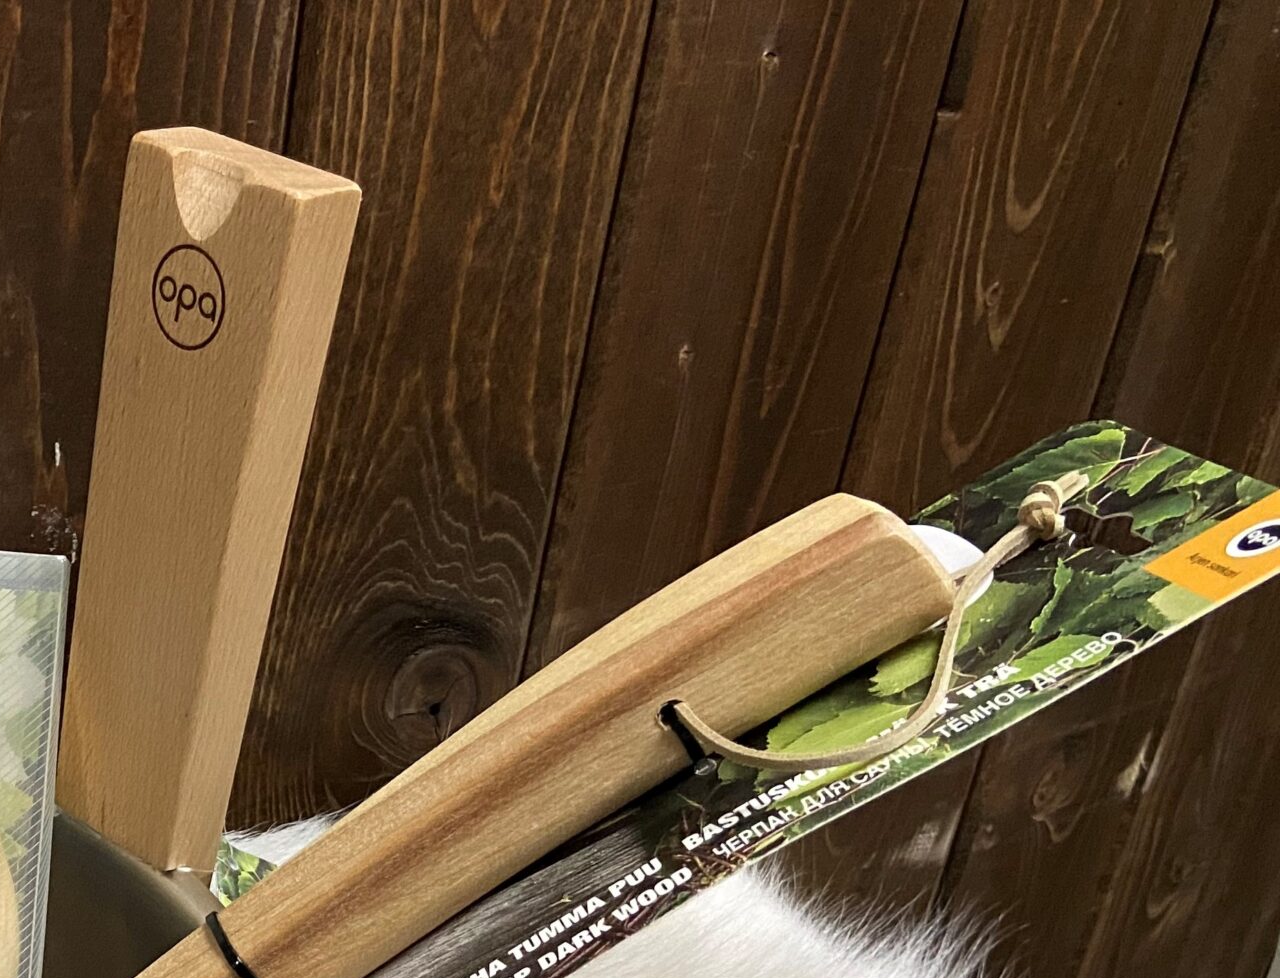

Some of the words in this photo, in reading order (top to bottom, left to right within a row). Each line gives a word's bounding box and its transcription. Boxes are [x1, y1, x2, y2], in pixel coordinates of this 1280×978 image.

[159, 275, 217, 323] opa
[681, 766, 838, 852] BASTUSK
[956, 661, 1022, 700] TRÄ
[712, 803, 801, 859] ЧЕРПАК
[800, 778, 851, 815] ДЛЯ
[933, 683, 1031, 739] ТЁМНОЕ
[1030, 631, 1122, 692] ДЕРЕВО
[507, 895, 607, 962] TUMMA
[608, 857, 663, 900] PUU
[537, 918, 614, 971] DARK
[612, 865, 694, 923] WOOD
